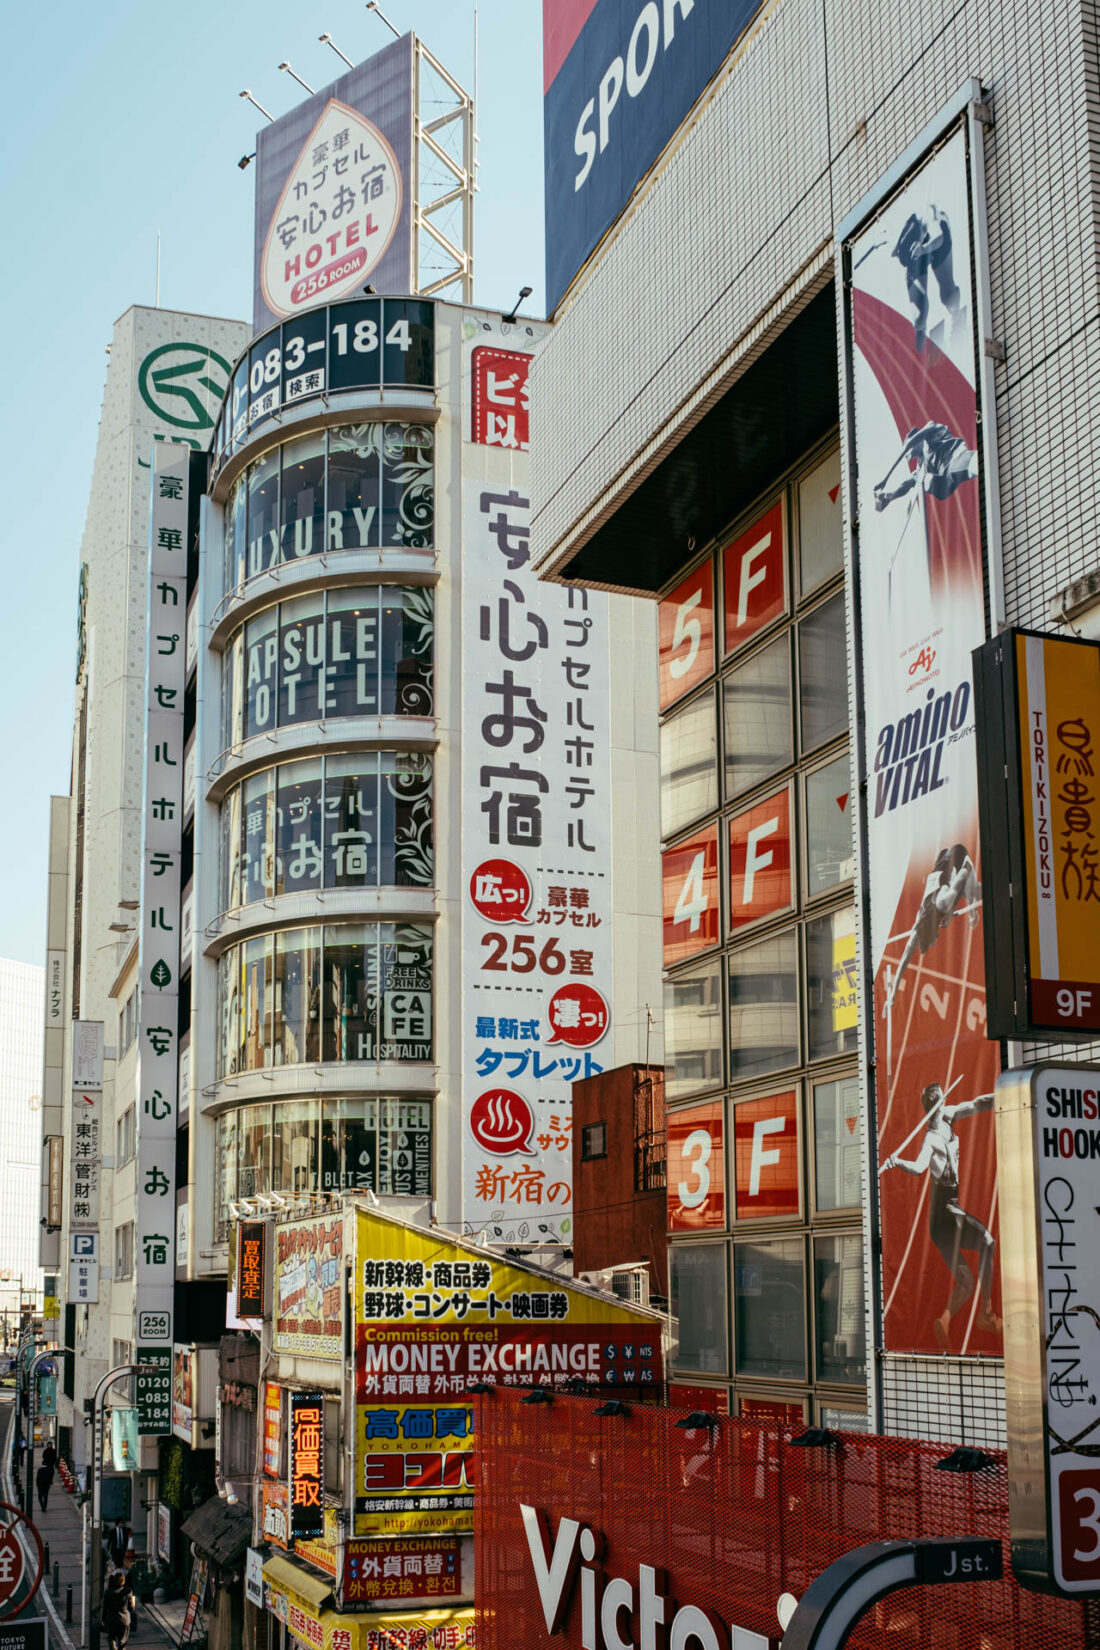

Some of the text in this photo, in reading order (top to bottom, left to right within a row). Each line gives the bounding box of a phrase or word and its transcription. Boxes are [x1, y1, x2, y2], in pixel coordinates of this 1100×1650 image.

[311, 128, 351, 167] 豪華
[293, 142, 371, 201] カプセル
[276, 163, 387, 250] 安心お宿
[284, 213, 379, 282] HOTEL
[296, 256, 362, 301] 256 ROOM
[289, 372, 320, 397] 検索
[479, 491, 549, 848] 安心お宿
[149, 476, 183, 933] 豪華カプセルホテル
[561, 583, 597, 852] カプセルホテル
[874, 680, 970, 773] amino
[874, 741, 944, 819] VITAL
[1032, 711, 1050, 889] TORIKIZOKU
[547, 885, 590, 910] 豪華
[536, 908, 602, 928] カプセル
[480, 931, 594, 976] 256室
[384, 967, 416, 978] FREE
[384, 979, 431, 990] DRINKS
[390, 994, 425, 1015] CA
[1056, 989, 1092, 1017] 9F
[391, 1017, 424, 1036] FE
[475, 1015, 541, 1042] 最新式
[358, 1032, 431, 1060] HOSPITALITY
[475, 1047, 604, 1082] タブレット
[142, 1024, 173, 1265] 安心お宿
[475, 1163, 572, 1206] 新宿の
[242, 1240, 260, 1299] 買取査定
[364, 1260, 491, 1289] 新幹線・商品券
[364, 1291, 569, 1319] 野球・コンサート・映画券
[143, 1316, 166, 1327] 256
[365, 1327, 499, 1342] Commission free!
[139, 1356, 170, 1367] ご予約
[365, 1343, 600, 1373] MONEY EXCHANGE
[138, 1377, 170, 1388] 0120
[365, 1374, 430, 1395] 外貨両替
[138, 1393, 170, 1403] -083
[138, 1408, 170, 1418] -184
[348, 1538, 457, 1554] MONEY EXCHANGE
[361, 1553, 444, 1579] 外貨両替
[1, 1636, 26, 1645] TOKYO
